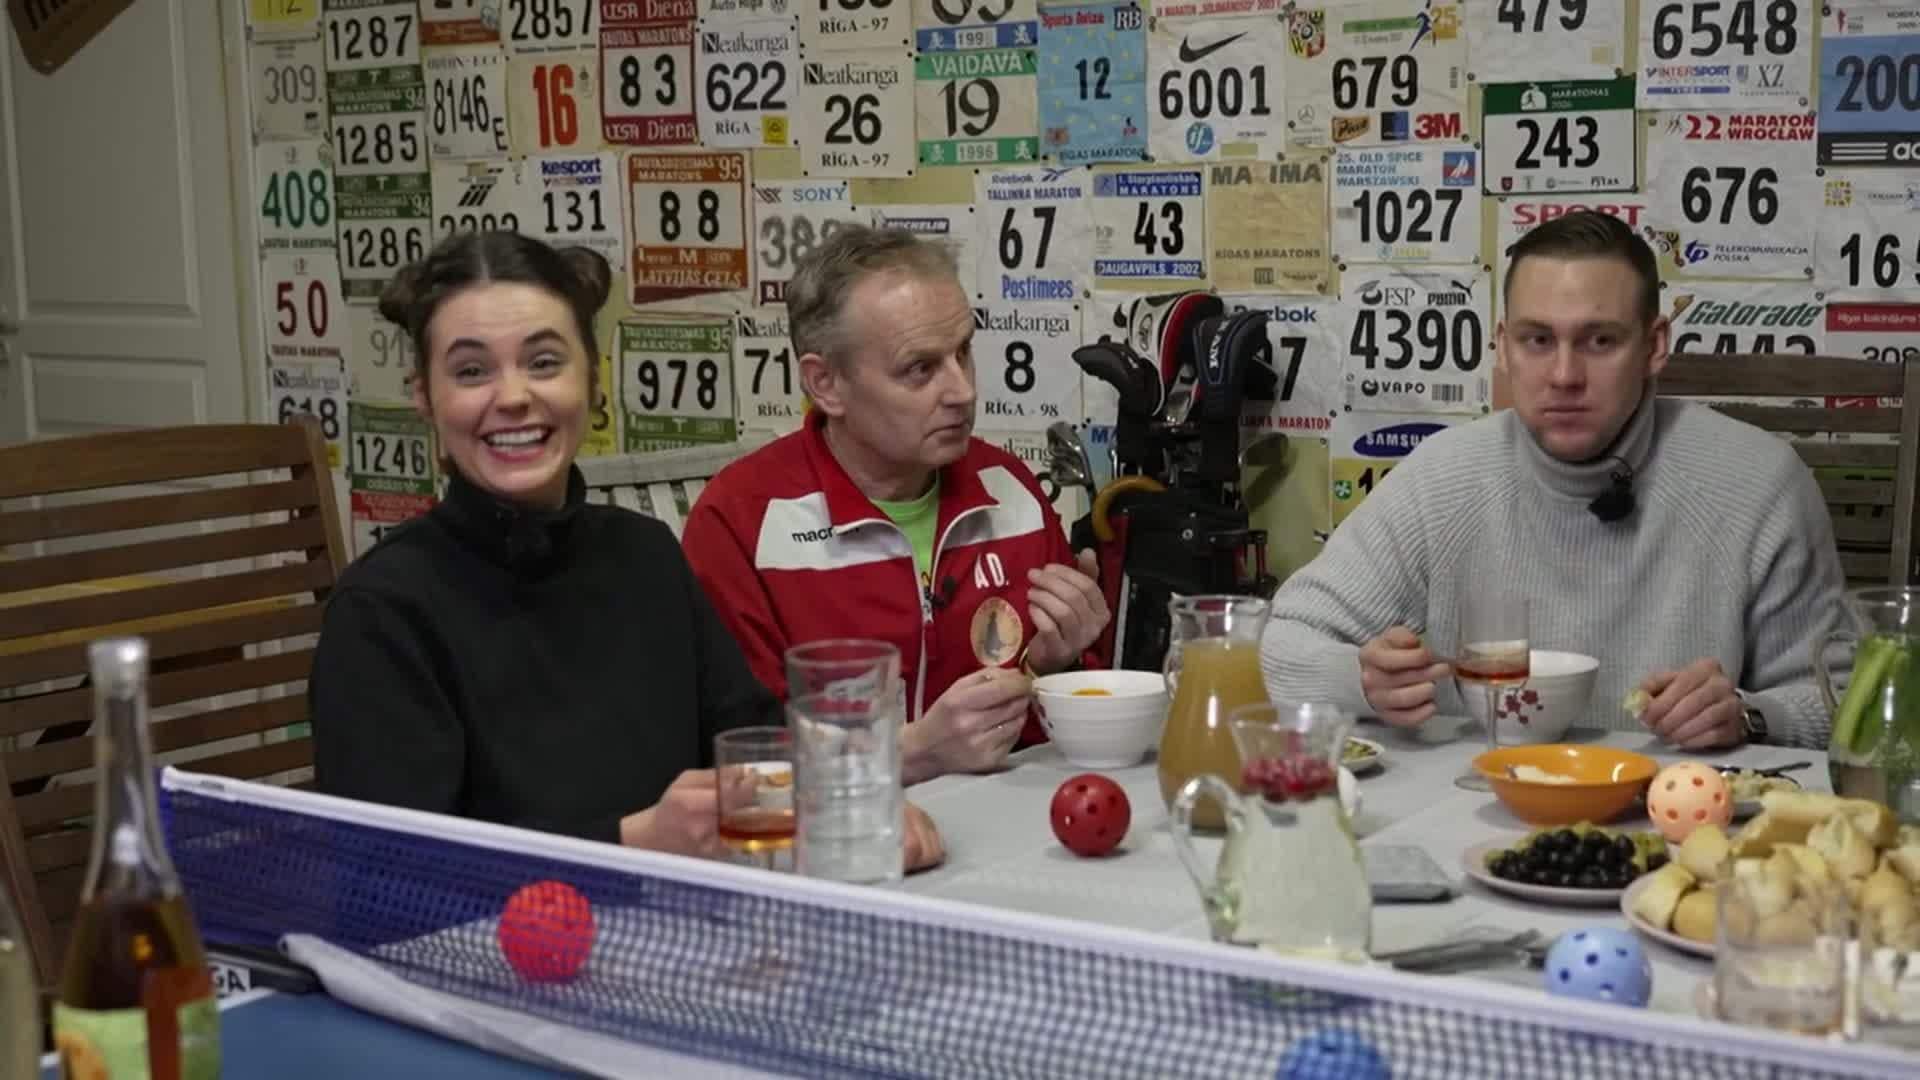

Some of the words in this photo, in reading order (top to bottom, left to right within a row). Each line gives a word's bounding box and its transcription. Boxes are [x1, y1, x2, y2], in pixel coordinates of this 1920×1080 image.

[509, 0, 592, 40] 2857
[871, 17, 889, 32] 97
[1116, 11, 1141, 31] RB
[1499, 0, 1587, 33] 479
[1653, 0, 1798, 59] 6548
[329, 15, 413, 60] 1287
[958, 32, 994, 47] 199
[931, 52, 1023, 76] VAIDAVA
[1074, 57, 1112, 100] 12
[1331, 54, 1418, 110] 679
[264, 65, 316, 104] 309
[706, 61, 787, 112] 622
[1159, 65, 1270, 119] 6001
[433, 75, 490, 136] 8146
[493, 117, 509, 152] E
[533, 64, 579, 148] 16
[824, 94, 882, 145] 26
[938, 78, 1001, 138] 19
[336, 121, 418, 166] 1285
[648, 119, 695, 140] Diena
[1415, 112, 1460, 140] 3M
[1515, 116, 1600, 169] 243
[1685, 114, 1721, 140] 22
[1728, 114, 1815, 127] MARATON
[872, 153, 890, 167] 97
[958, 142, 994, 161] 1996
[1337, 164, 1396, 175] MARATON
[1359, 152, 1383, 163] OLD
[1034, 186, 1082, 199] MARATON
[1119, 185, 1199, 195] MARATONS
[1211, 162, 1322, 187] MAIMA
[1336, 174, 1420, 186] WARSZAWSKI
[261, 170, 330, 228] 408
[543, 190, 606, 233] 131
[792, 187, 847, 201] SONY
[1682, 167, 1778, 225] 676
[1134, 201, 1184, 255] 43
[1353, 188, 1463, 243] 1027
[1512, 203, 1646, 226] SPT
[343, 227, 424, 268] 1286
[1000, 206, 1057, 269] 67
[1253, 248, 1322, 259] MARATONS
[1097, 262, 1166, 275] DAUGAVPILS
[1172, 262, 1200, 274] 2002
[1713, 254, 1751, 262] POLSKA
[1840, 233, 1920, 288] 16
[1001, 274, 1074, 301] Postimees
[1384, 286, 1416, 307] FSP
[1426, 291, 1467, 306] PUMA
[276, 280, 329, 338] 50
[1232, 304, 1318, 325] Rbok
[1684, 299, 1823, 328] Gatorade
[1350, 309, 1482, 373] 4390
[637, 360, 718, 410] 978
[1004, 340, 1036, 394] 8
[1280, 336, 1308, 401] 7
[1382, 381, 1426, 394] VAPO
[279, 397, 340, 440] 68
[1040, 403, 1059, 418] 98
[356, 435, 426, 476] 1246
[1366, 432, 1421, 448] SAMSU
